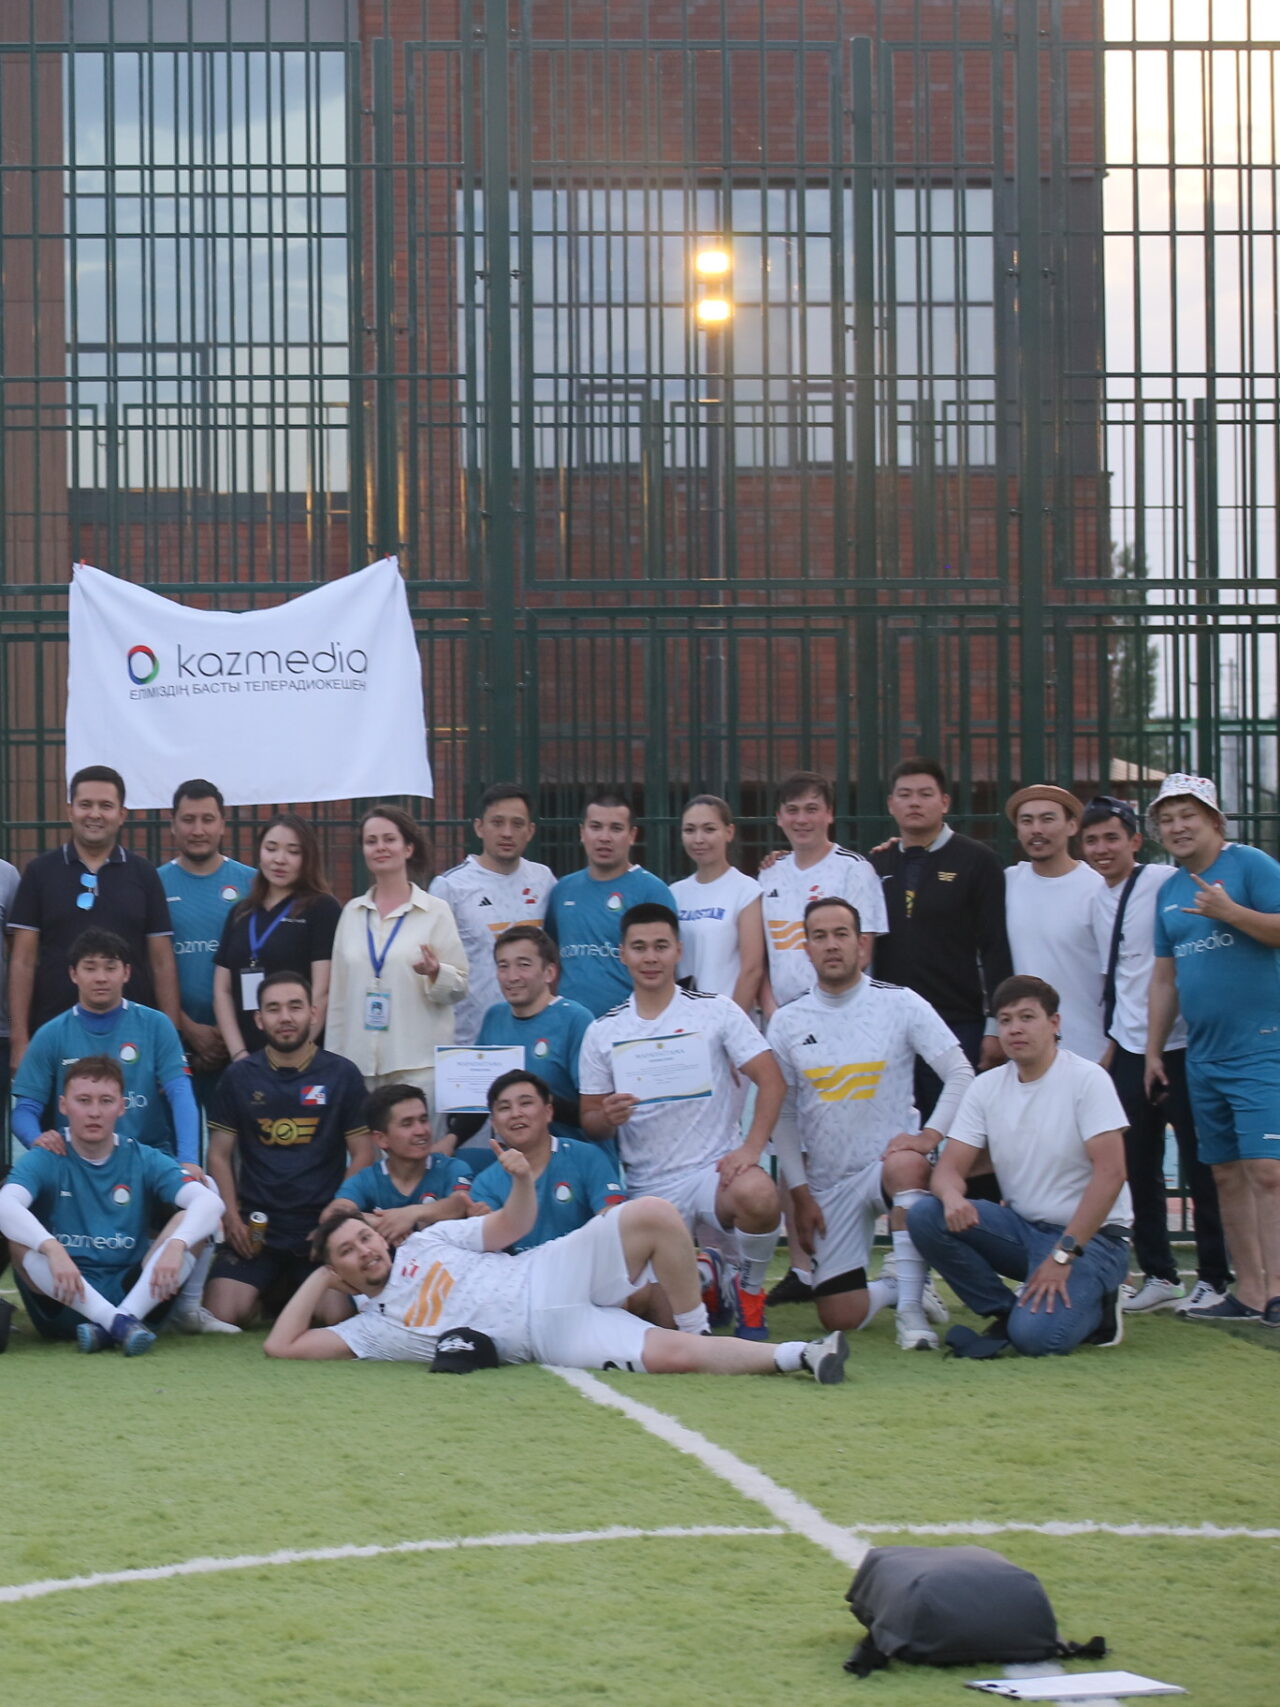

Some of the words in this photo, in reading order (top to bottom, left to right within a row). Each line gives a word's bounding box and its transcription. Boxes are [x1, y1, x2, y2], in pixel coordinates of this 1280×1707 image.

[177, 642, 368, 678] kazmedia
[193, 680, 241, 695] БАСТЫ
[54, 1232, 136, 1250] azmedia
